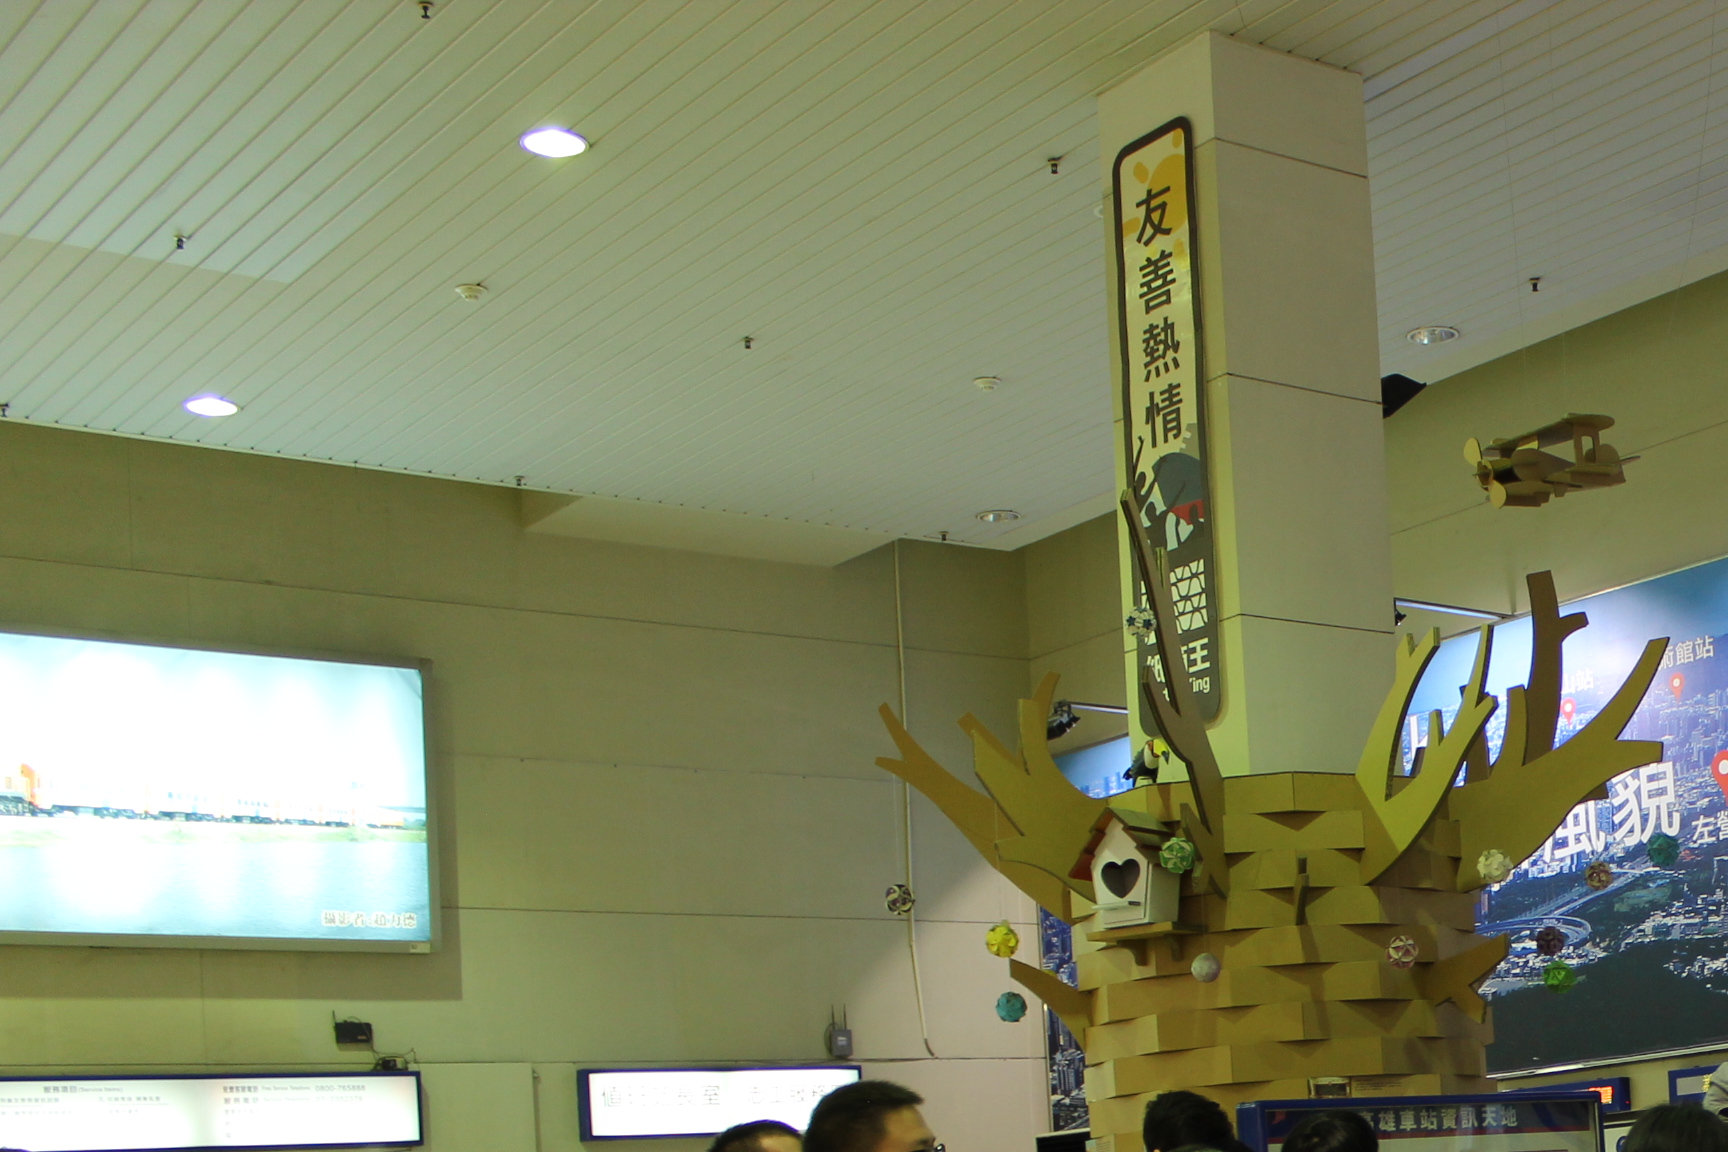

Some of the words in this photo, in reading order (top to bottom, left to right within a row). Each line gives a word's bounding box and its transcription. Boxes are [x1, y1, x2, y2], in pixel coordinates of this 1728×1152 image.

[1134, 184, 1183, 450] 友善熱情
[1660, 634, 1714, 668] 術館站
[1189, 675, 1211, 695] ing
[1560, 667, 1594, 694] 山站
